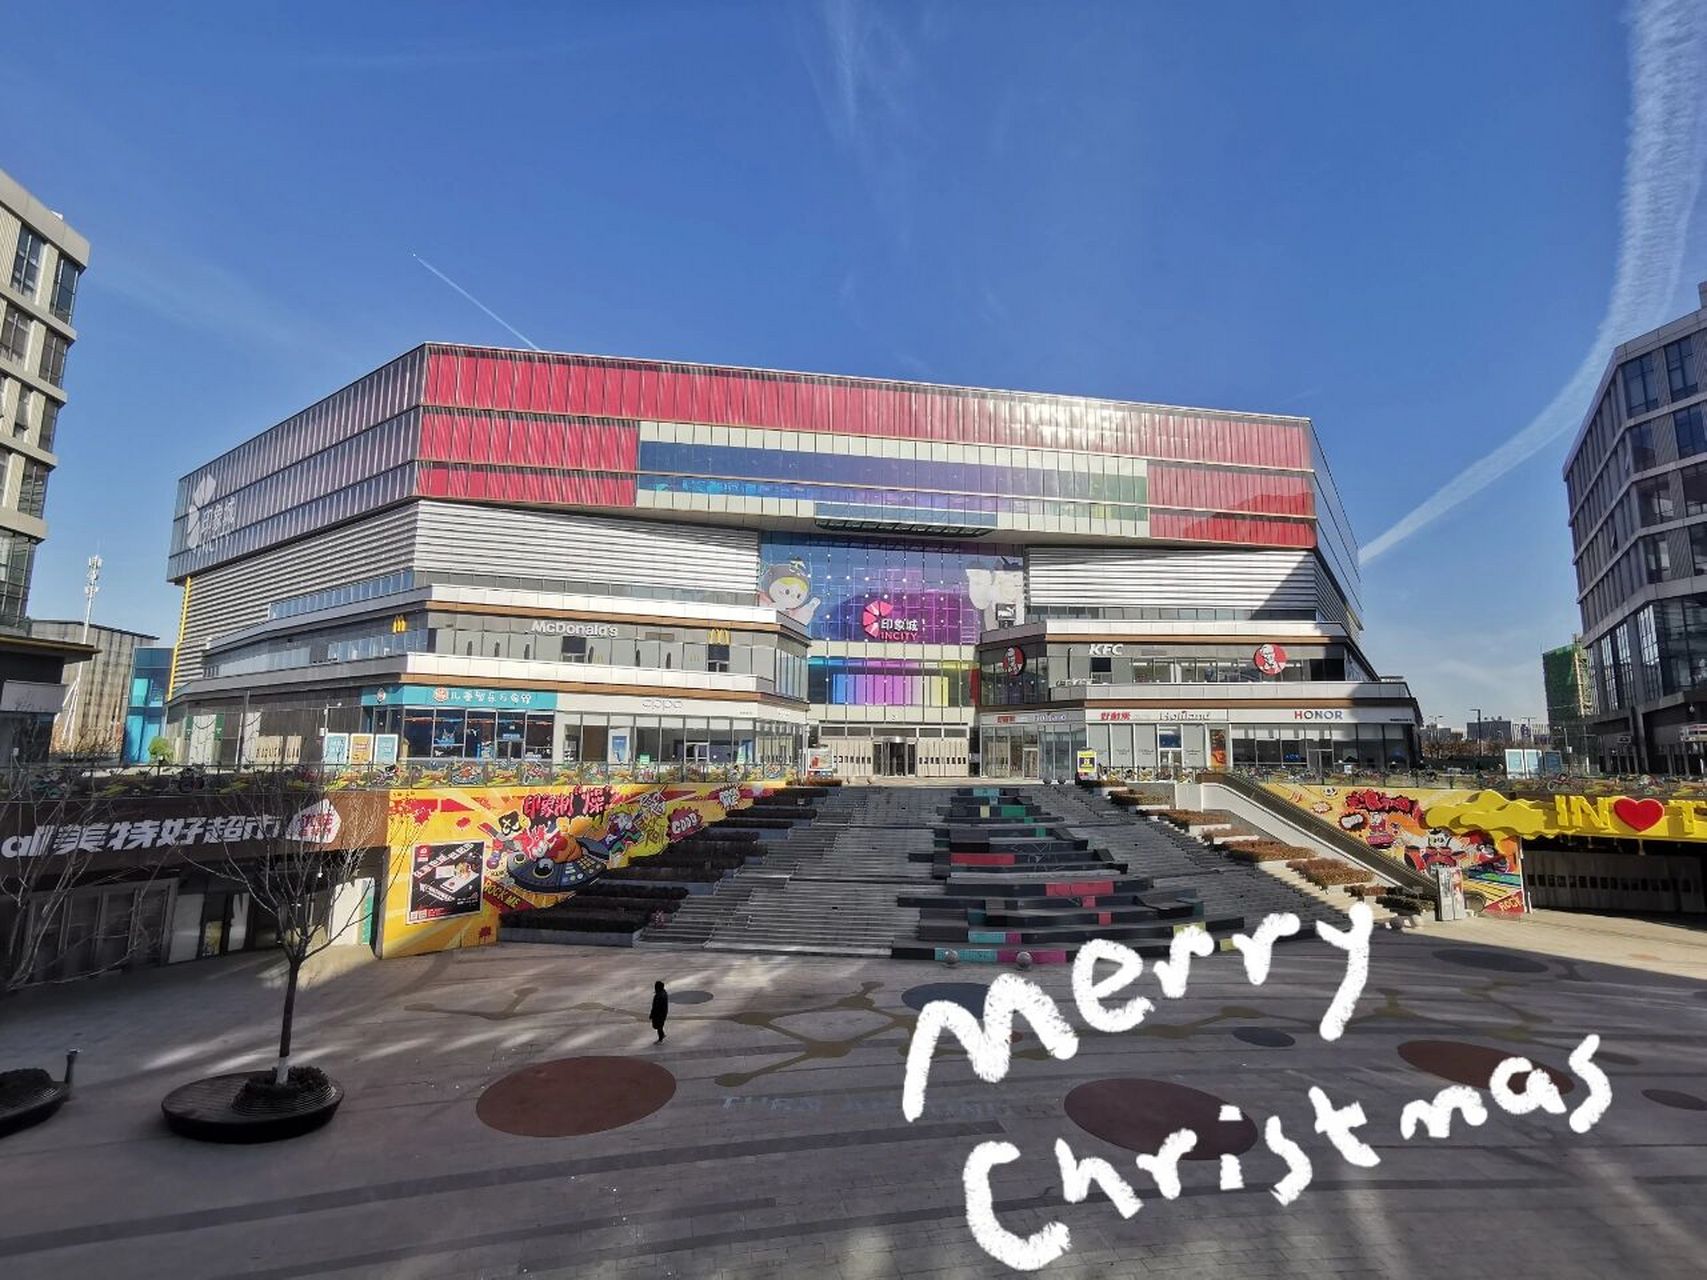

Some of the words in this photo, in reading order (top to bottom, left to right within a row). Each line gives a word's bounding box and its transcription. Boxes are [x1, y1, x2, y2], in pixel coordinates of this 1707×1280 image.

[531, 620, 618, 637] McDonald's
[881, 618, 918, 631] 印象城
[881, 631, 917, 640] INCITY
[1089, 644, 1123, 655] KFC
[1294, 710, 1343, 720] HONOR
[484, 879, 504, 901] ROCK
